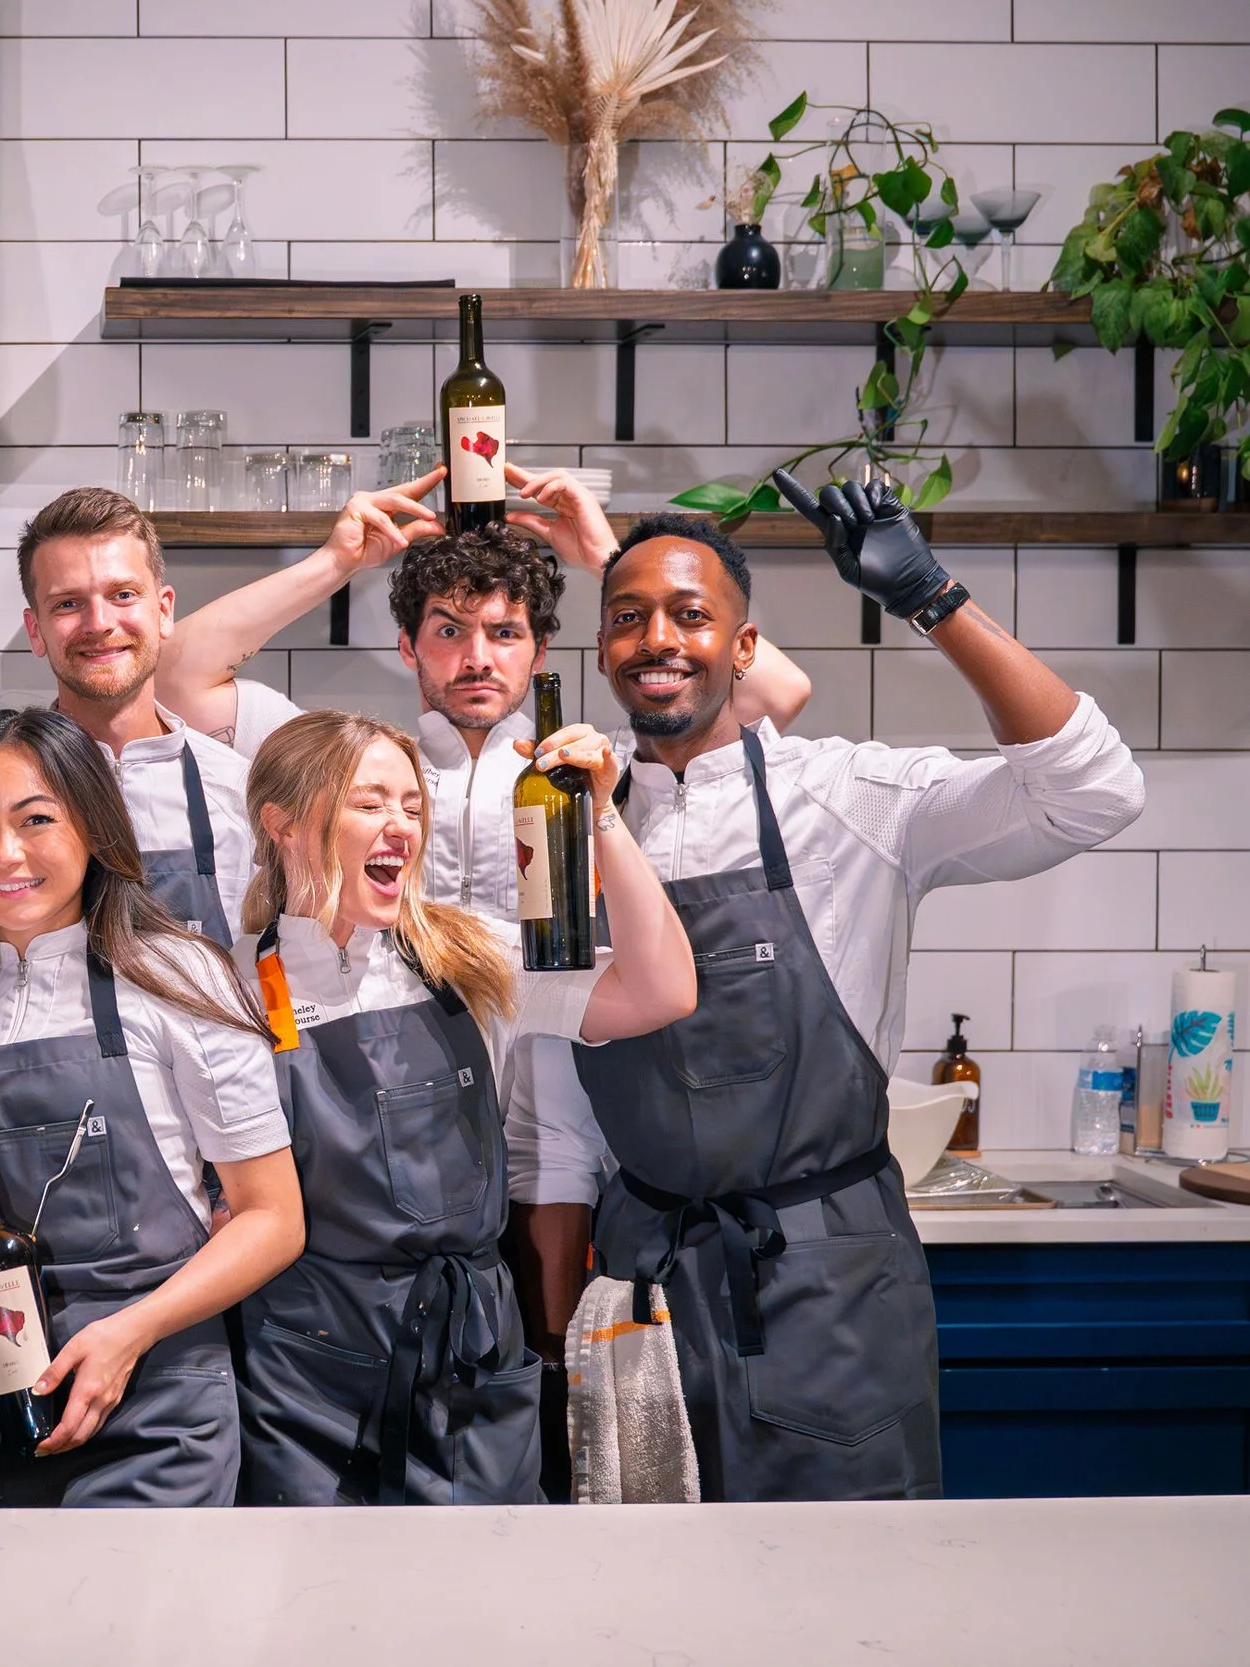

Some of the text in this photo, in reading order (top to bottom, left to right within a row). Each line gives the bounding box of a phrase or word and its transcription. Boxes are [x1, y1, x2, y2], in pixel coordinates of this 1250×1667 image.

[760, 946, 770, 958] &
[294, 1014, 321, 1025] ourse
[92, 1120, 102, 1133] &
